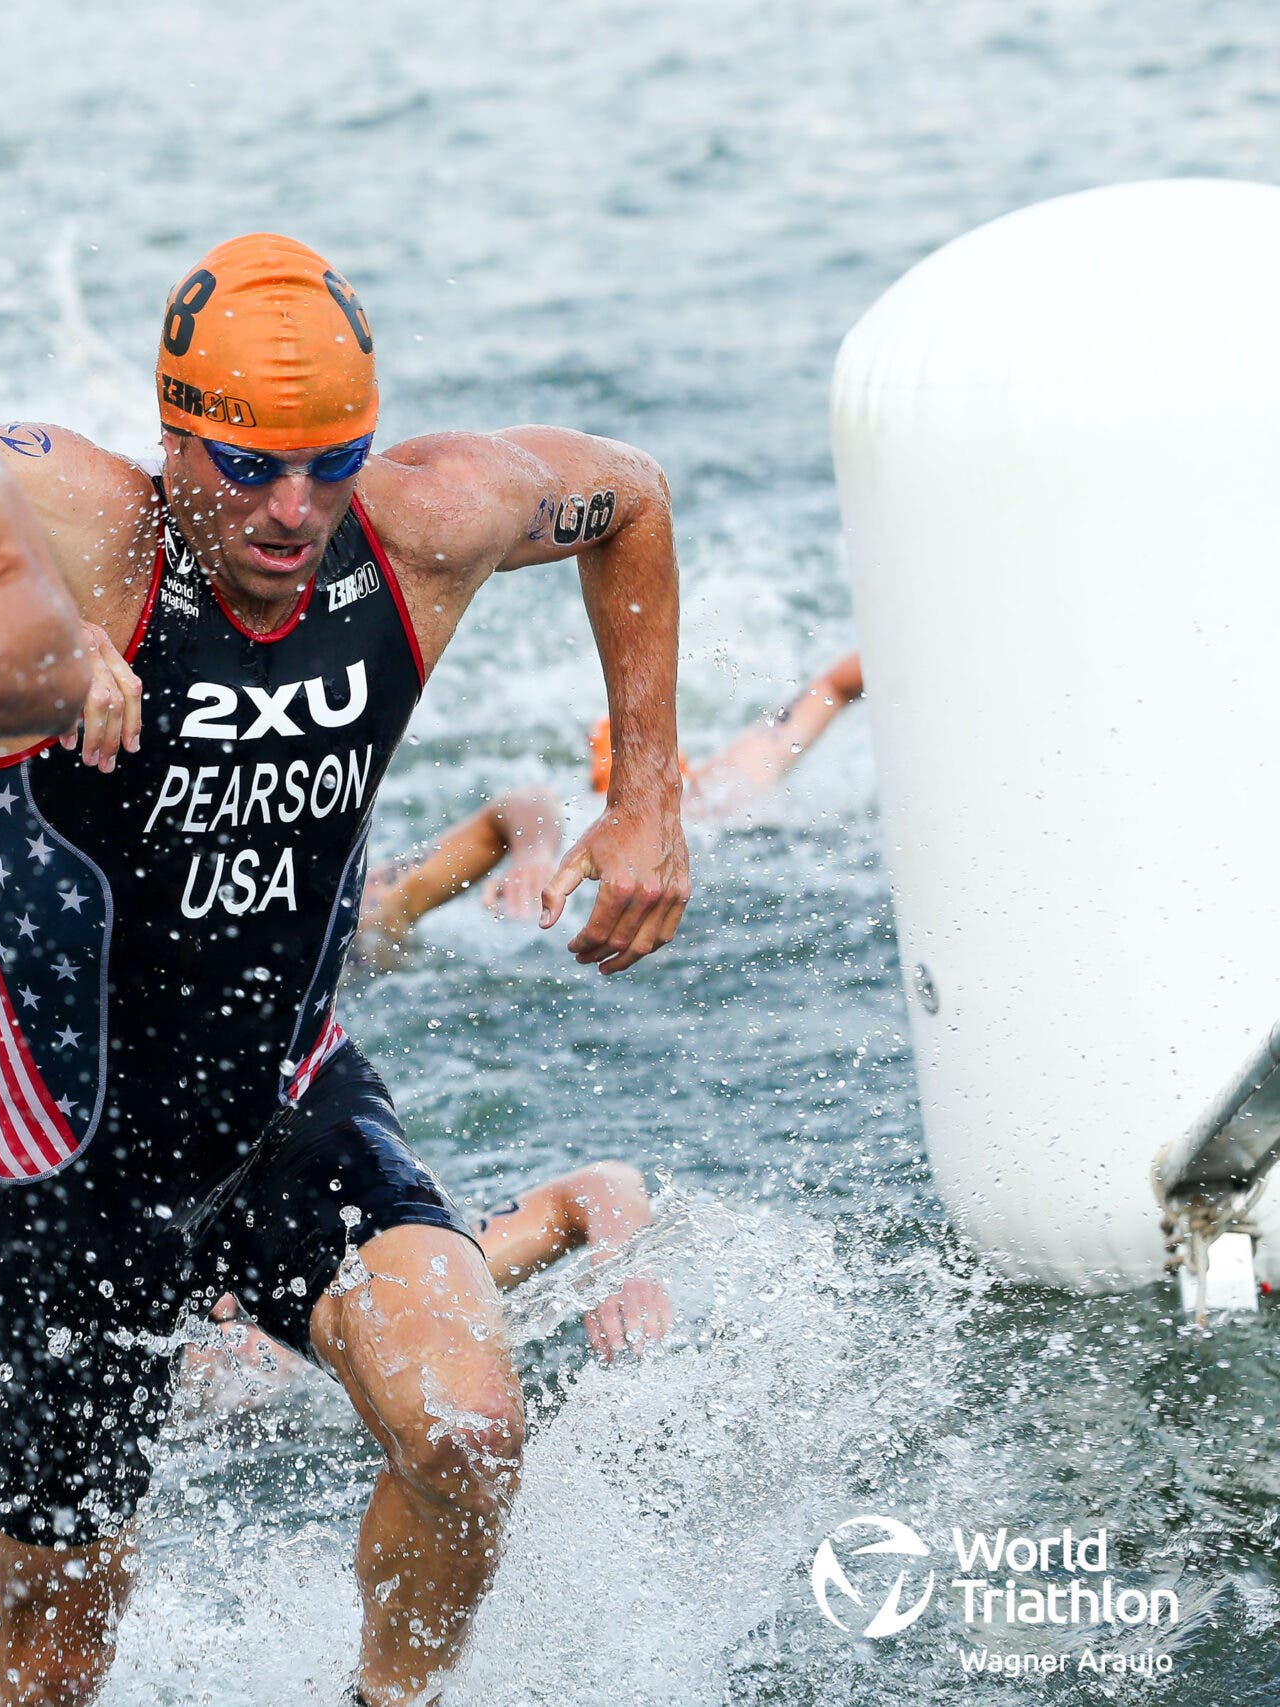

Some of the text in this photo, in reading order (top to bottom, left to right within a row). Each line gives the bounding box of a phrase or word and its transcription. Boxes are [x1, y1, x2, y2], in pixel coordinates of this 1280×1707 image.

[163, 268, 217, 357] 8
[323, 269, 373, 355] 8
[160, 587, 200, 619] Triathlon
[164, 575, 194, 600] World
[179, 658, 368, 741] 2XU
[142, 743, 373, 834] PEARSON
[180, 846, 297, 920] USA
